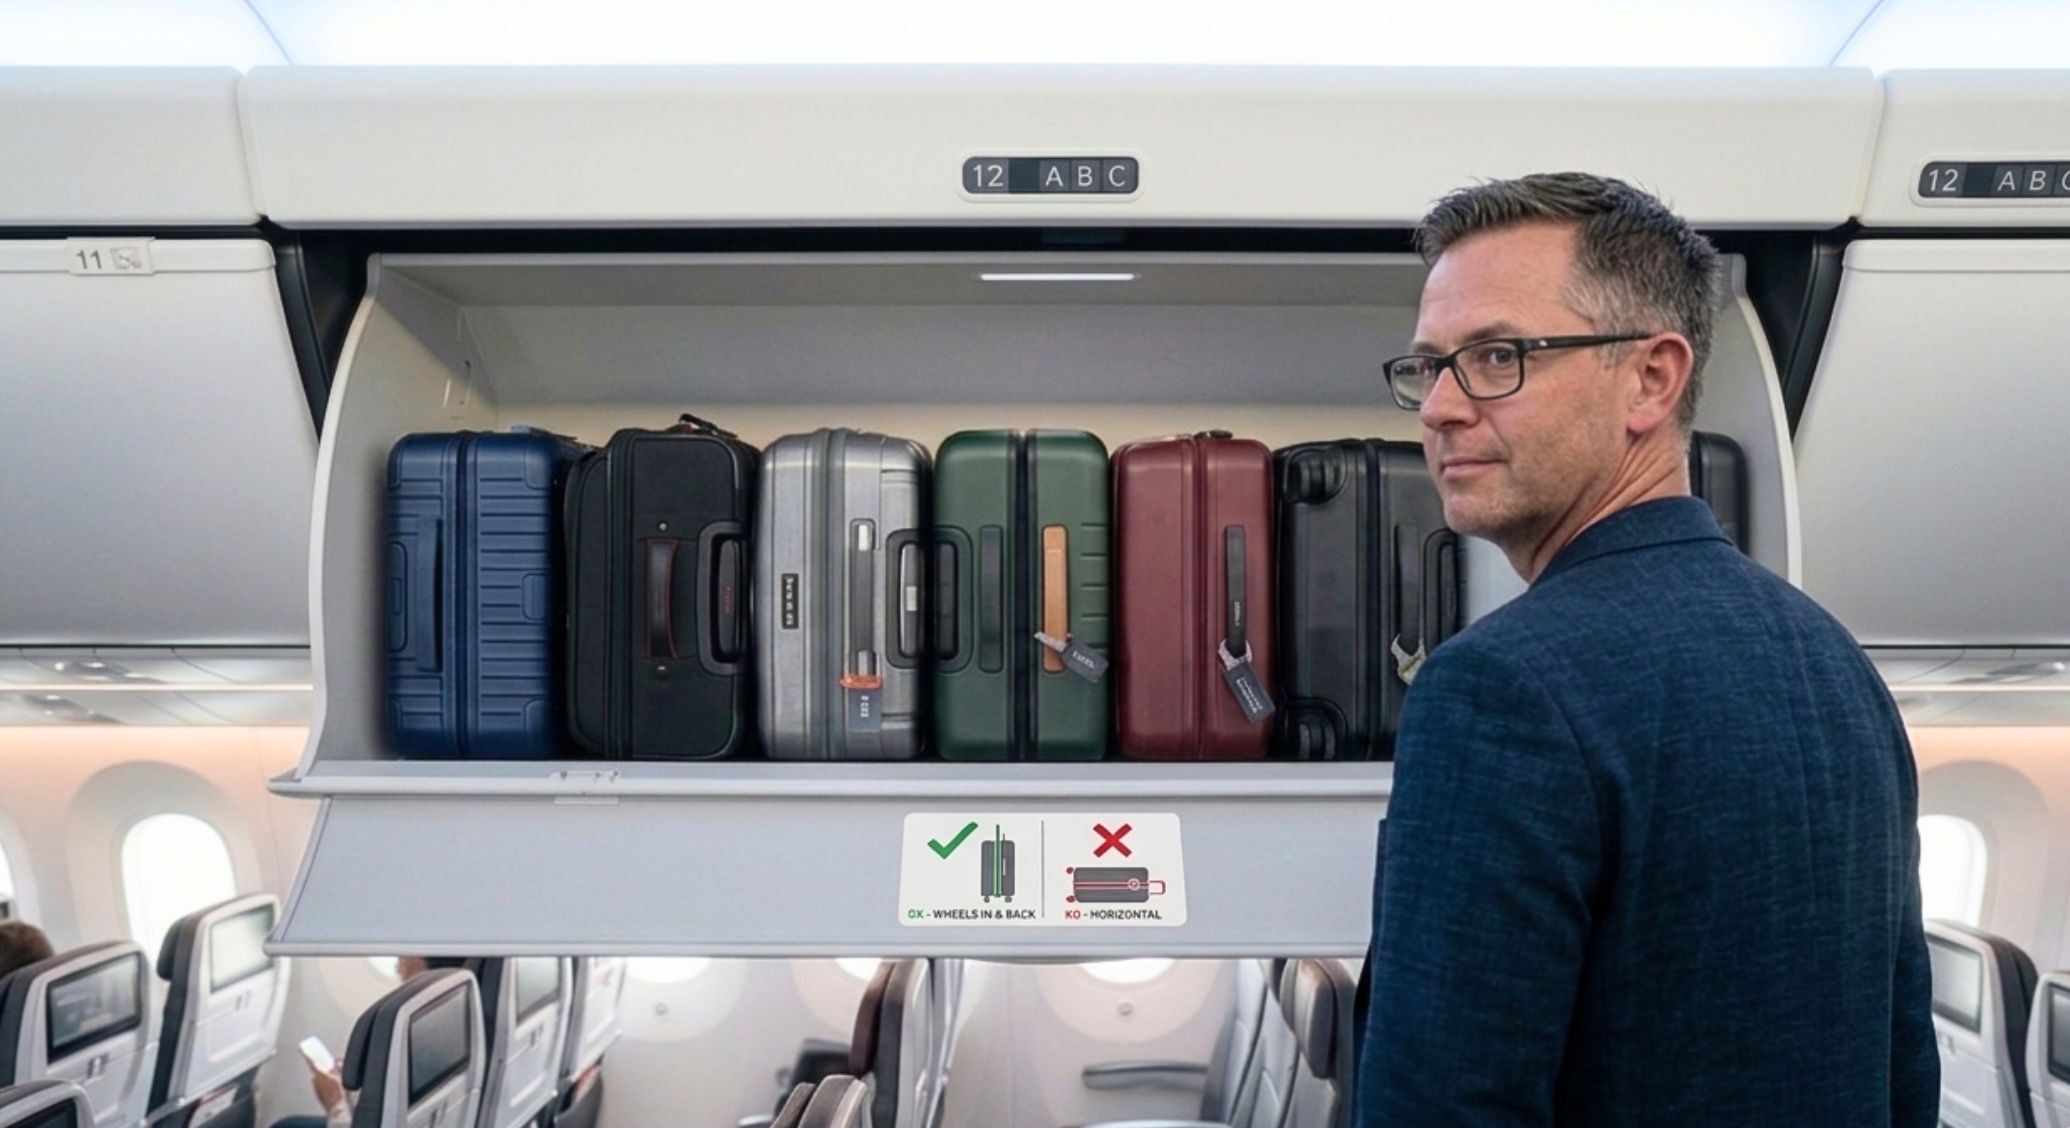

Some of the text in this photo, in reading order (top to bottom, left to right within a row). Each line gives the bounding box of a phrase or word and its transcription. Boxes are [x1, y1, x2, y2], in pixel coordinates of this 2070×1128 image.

[973, 164, 1126, 187] 12 A B C
[1929, 168, 1958, 192] 12
[1997, 170, 2016, 191] A
[2029, 170, 2047, 191] B
[76, 249, 102, 270] 11
[932, 909, 979, 919] WHEELS
[980, 909, 992, 919] IN
[994, 909, 1004, 919] &
[1006, 909, 1036, 919] BACK
[1064, 909, 1081, 919] KO
[1090, 909, 1162, 920] HORIZONTAL
